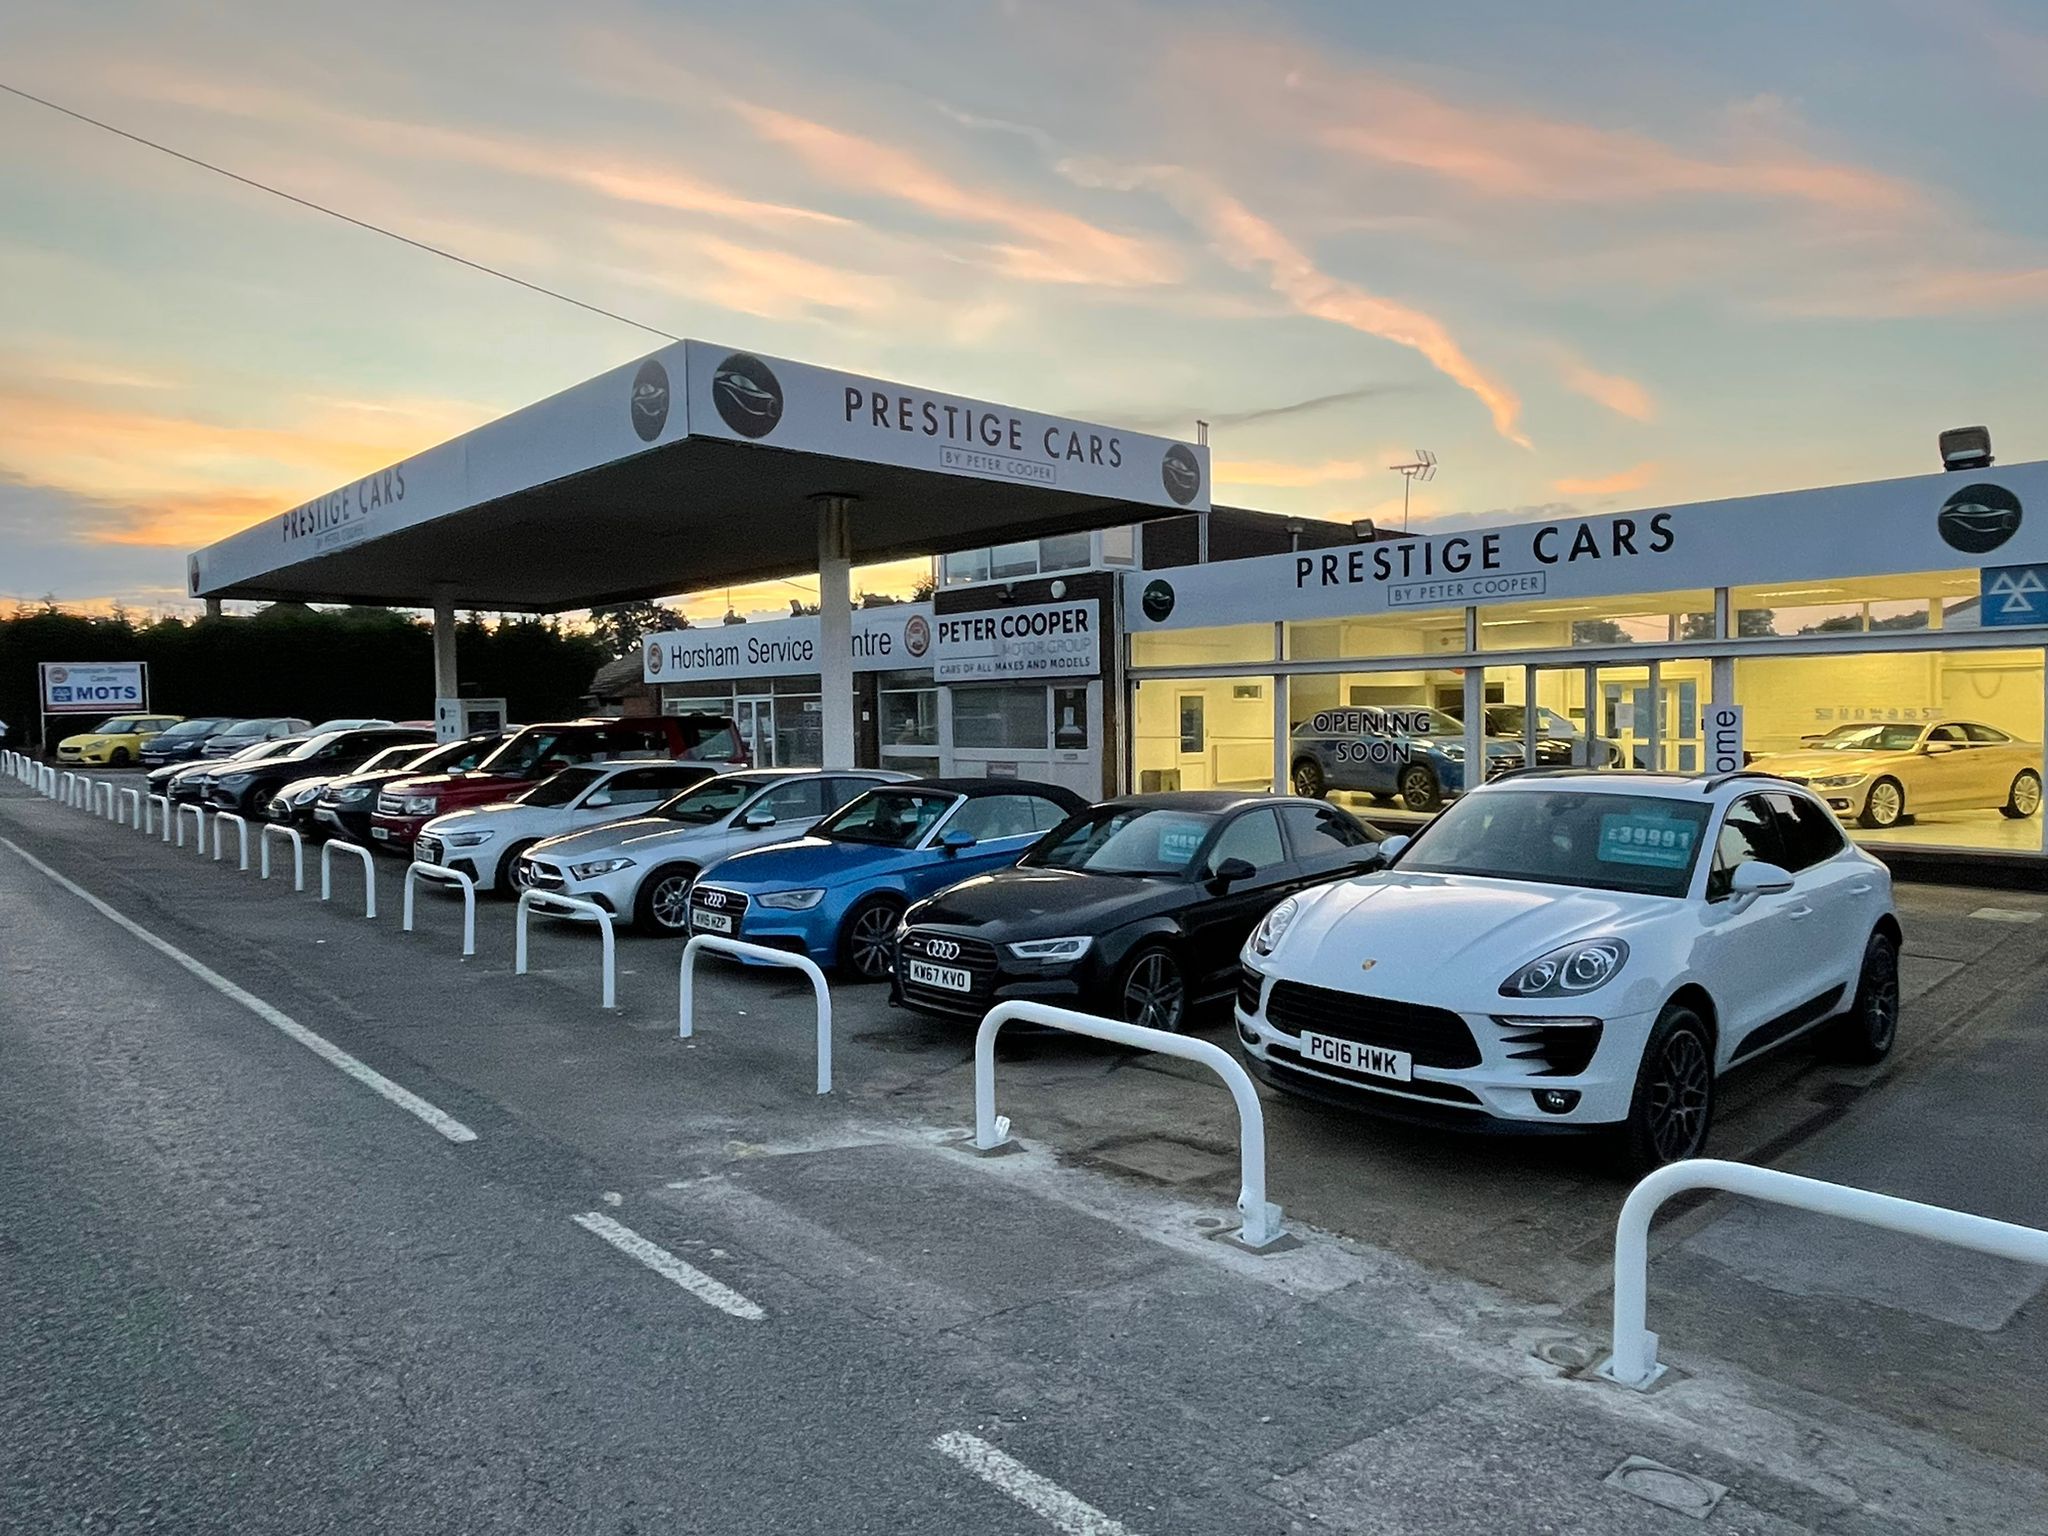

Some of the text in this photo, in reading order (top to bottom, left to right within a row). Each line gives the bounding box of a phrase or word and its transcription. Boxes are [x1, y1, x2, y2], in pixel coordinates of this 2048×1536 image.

[844, 386, 1122, 468] PRESTIGE CARS
[945, 451, 1050, 480] BY PETER COOPER
[282, 486, 350, 543] PRESTIGE
[358, 463, 405, 514] CARS
[1296, 512, 1675, 588] PRESTIGE CARS
[1394, 577, 1538, 600] BY PETER COOPER
[938, 608, 1089, 644] PETER COOPER
[671, 628, 891, 669] Horsham Service ntre
[1049, 637, 1091, 653] GROUP
[995, 659, 1024, 672] MAKES
[1027, 659, 1047, 670] AND
[1050, 657, 1090, 669] MODELS
[76, 686, 137, 700] MOTS
[1312, 712, 1431, 733] OPENING
[1337, 741, 1410, 762] SOON
[1716, 711, 1736, 773] ome
[914, 964, 939, 982] KW67
[1311, 1036, 1397, 1075] PG16 HWK
